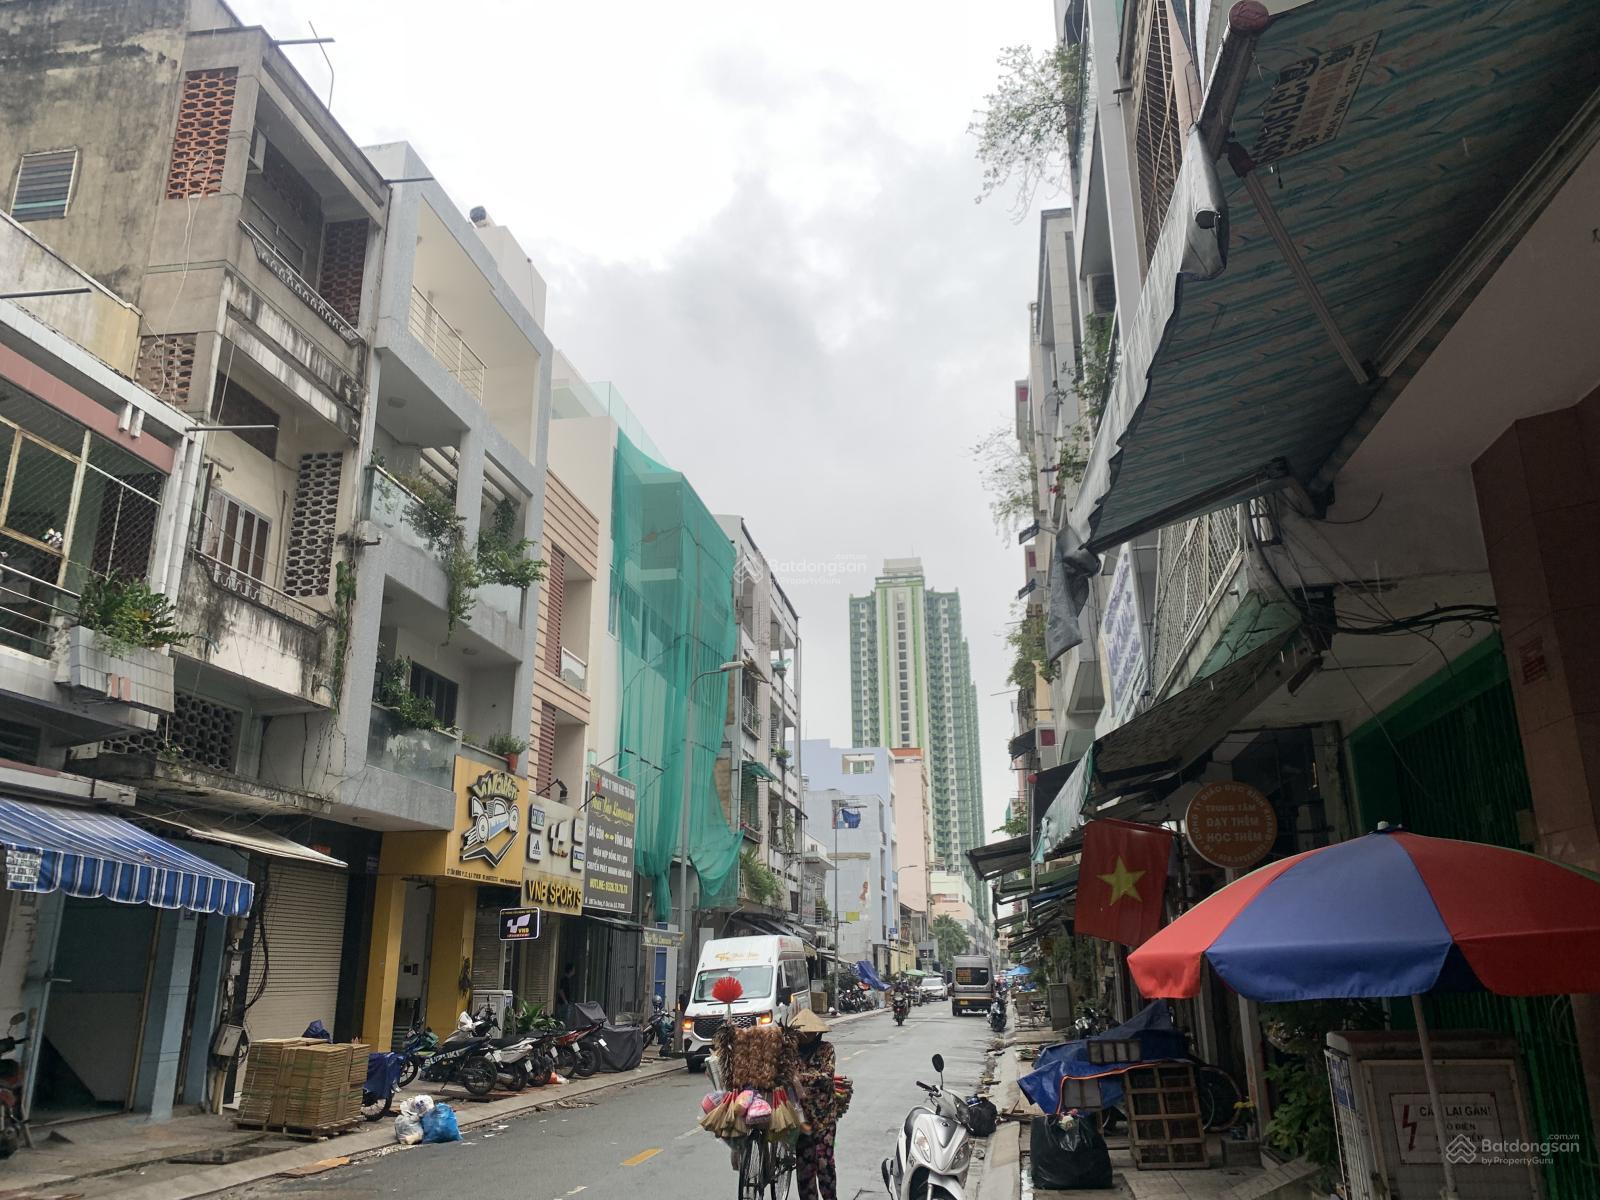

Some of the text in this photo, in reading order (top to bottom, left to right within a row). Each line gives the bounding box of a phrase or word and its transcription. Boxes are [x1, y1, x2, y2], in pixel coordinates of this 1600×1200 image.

[1232, 815, 1259, 827] THÊM
[1235, 830, 1262, 843] THÊM
[528, 880, 548, 902] VNB
[550, 883, 582, 908] SPORTS
[424, 1051, 459, 1067] SUZUKI
